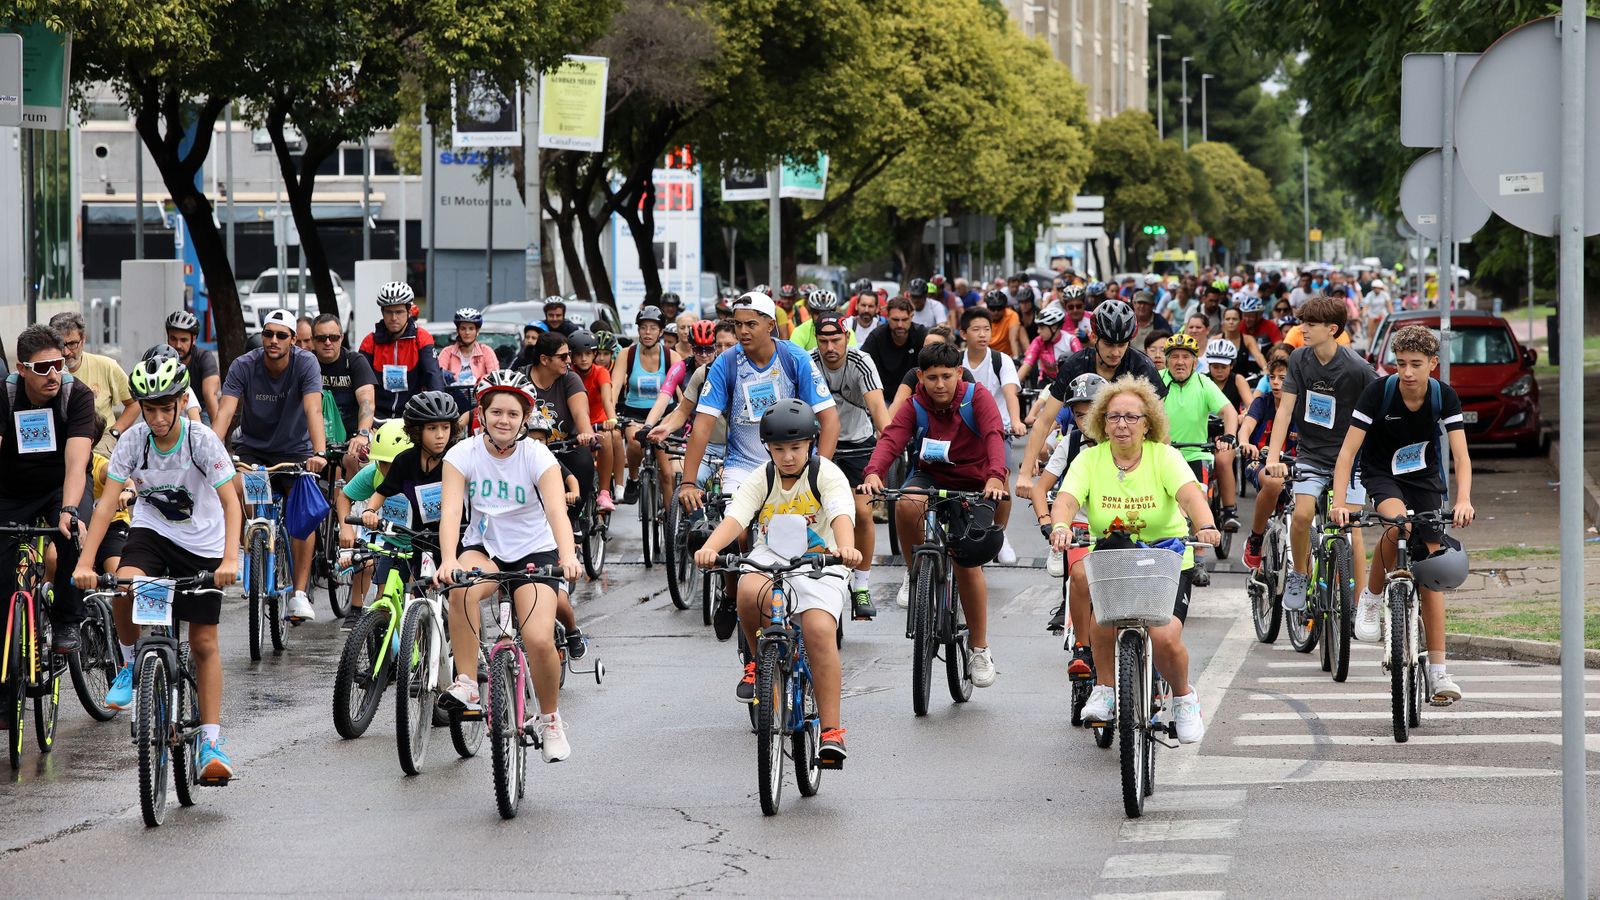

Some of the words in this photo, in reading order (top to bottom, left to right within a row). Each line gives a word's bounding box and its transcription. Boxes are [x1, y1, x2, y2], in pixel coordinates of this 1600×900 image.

[440, 196, 451, 206] El
[454, 196, 512, 206] Motorsta
[467, 479, 526, 505] SOHO
[1124, 495, 1154, 503] SANGRE
